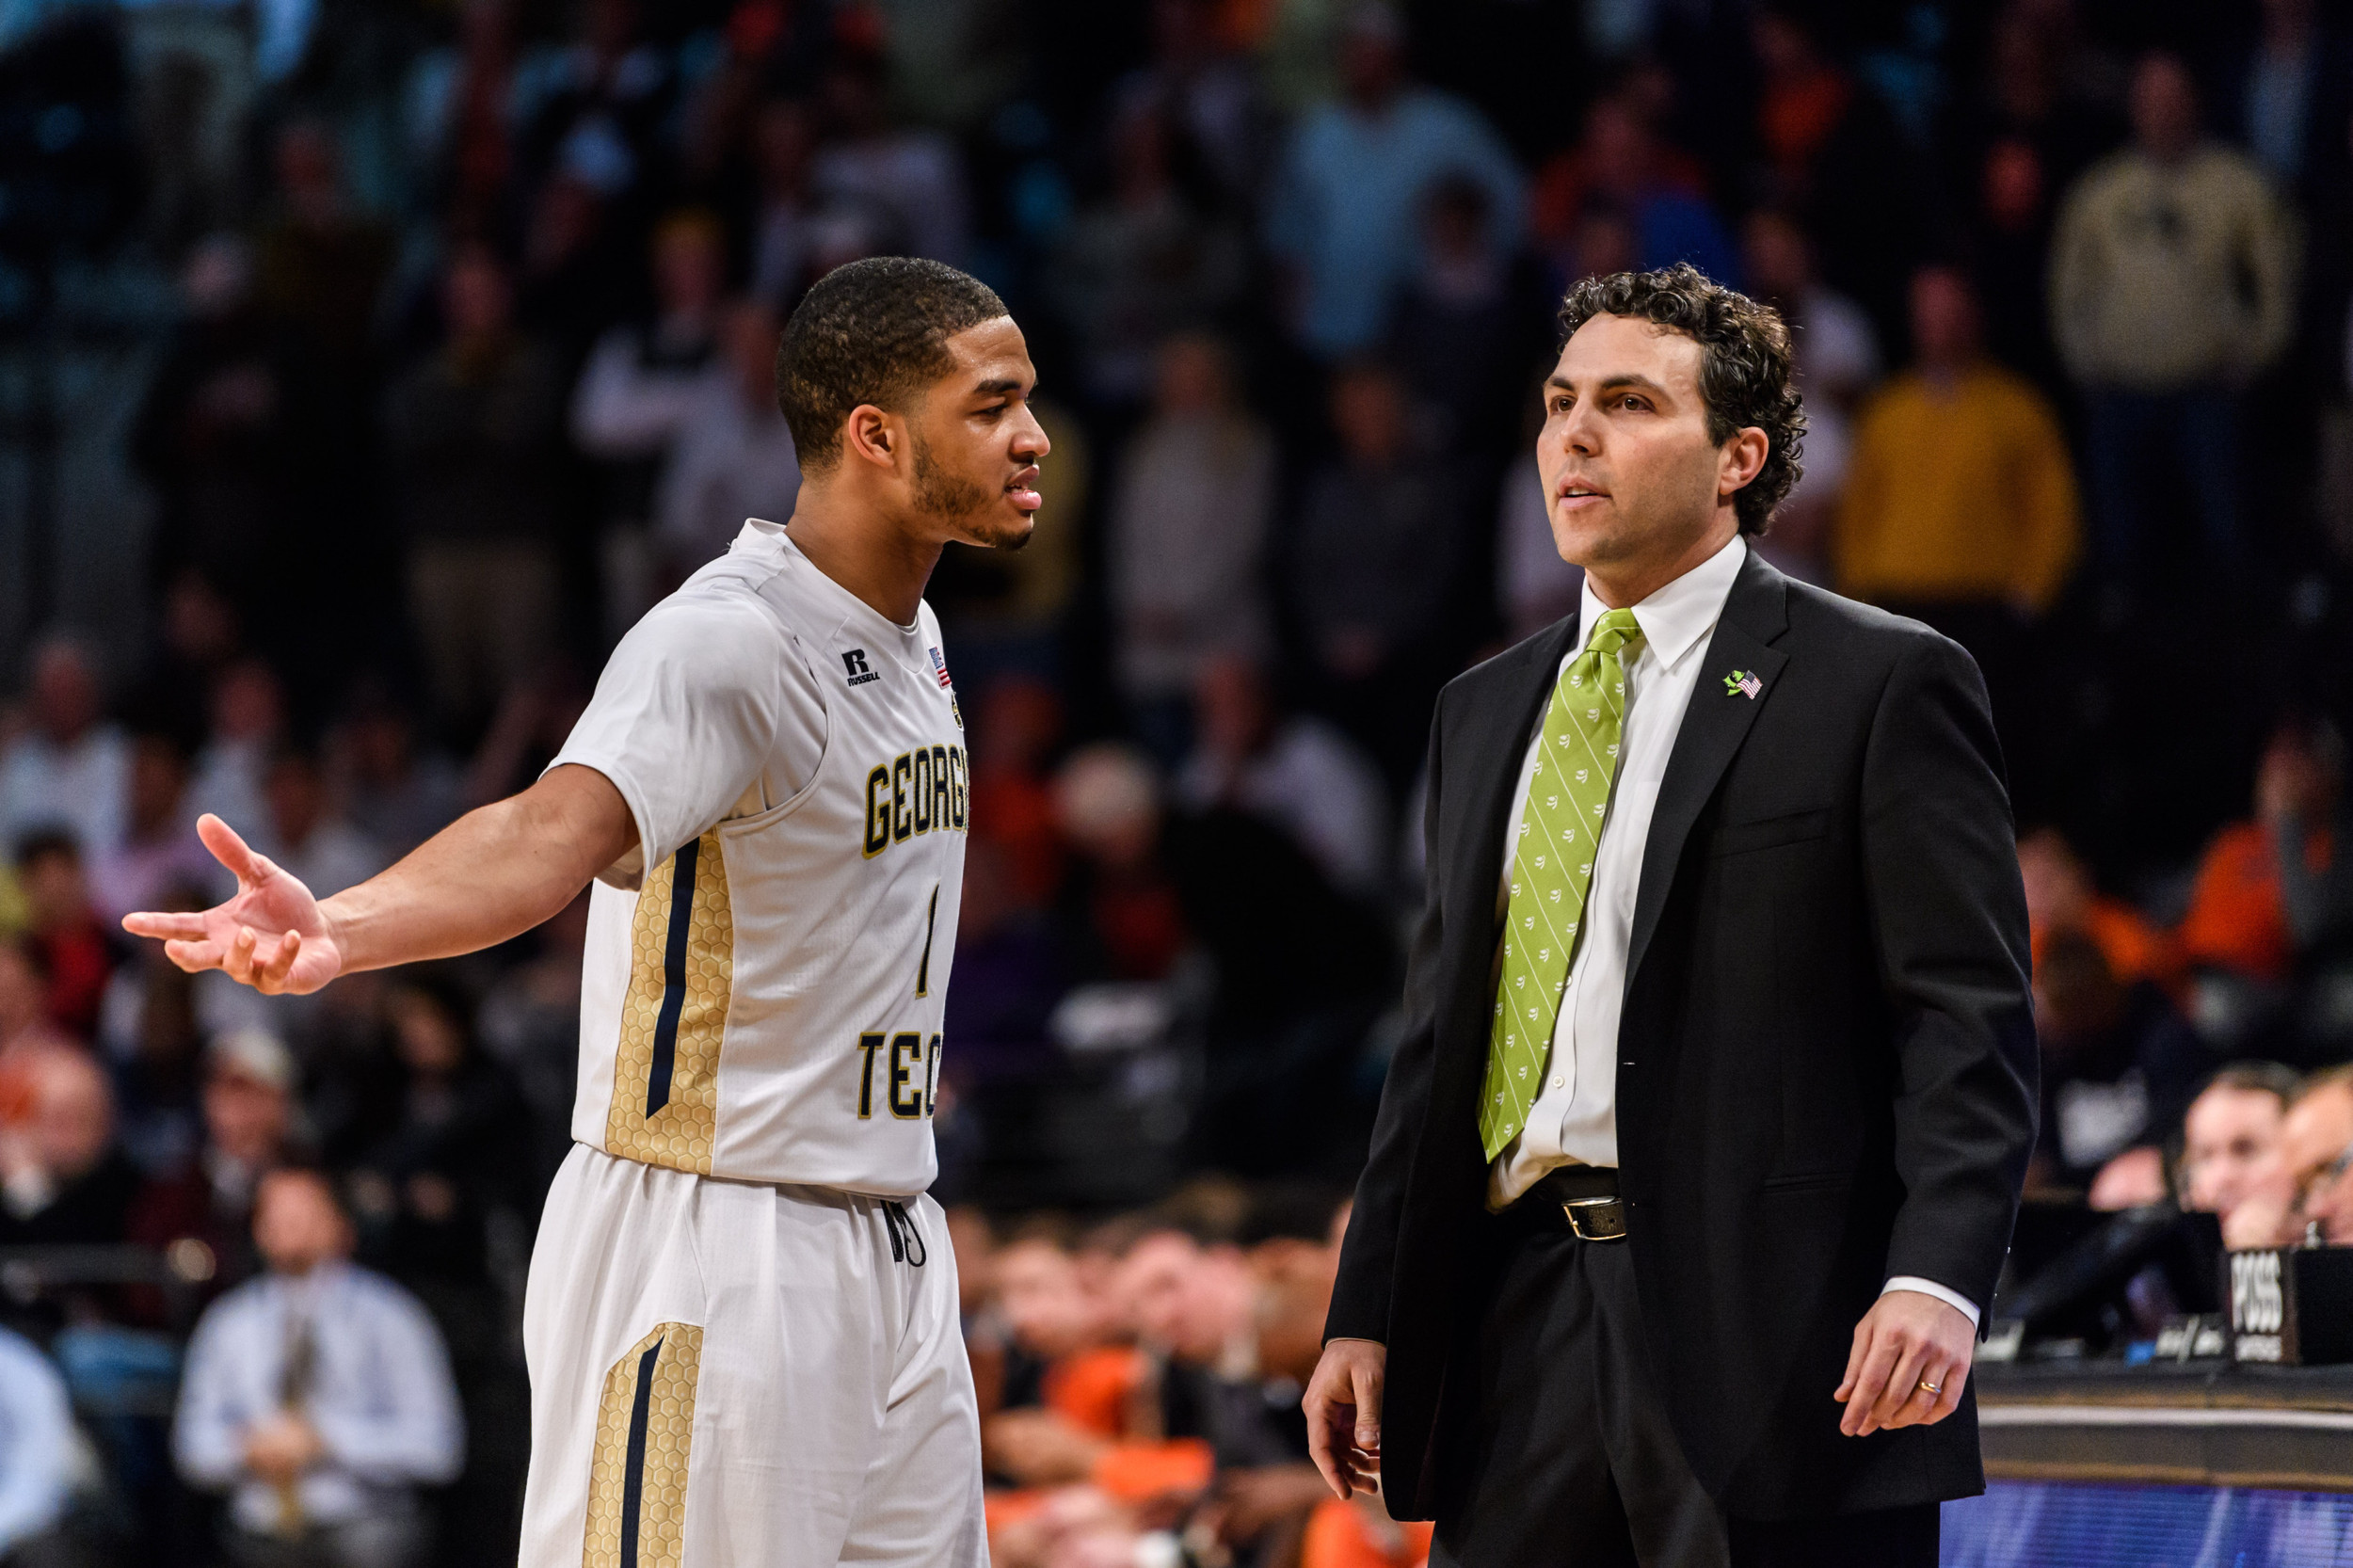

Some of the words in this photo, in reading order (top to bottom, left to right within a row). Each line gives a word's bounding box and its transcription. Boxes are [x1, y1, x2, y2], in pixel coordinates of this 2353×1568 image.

[841, 648, 870, 676] R
[847, 672, 880, 687] RUSSELL
[915, 882, 940, 999] 1
